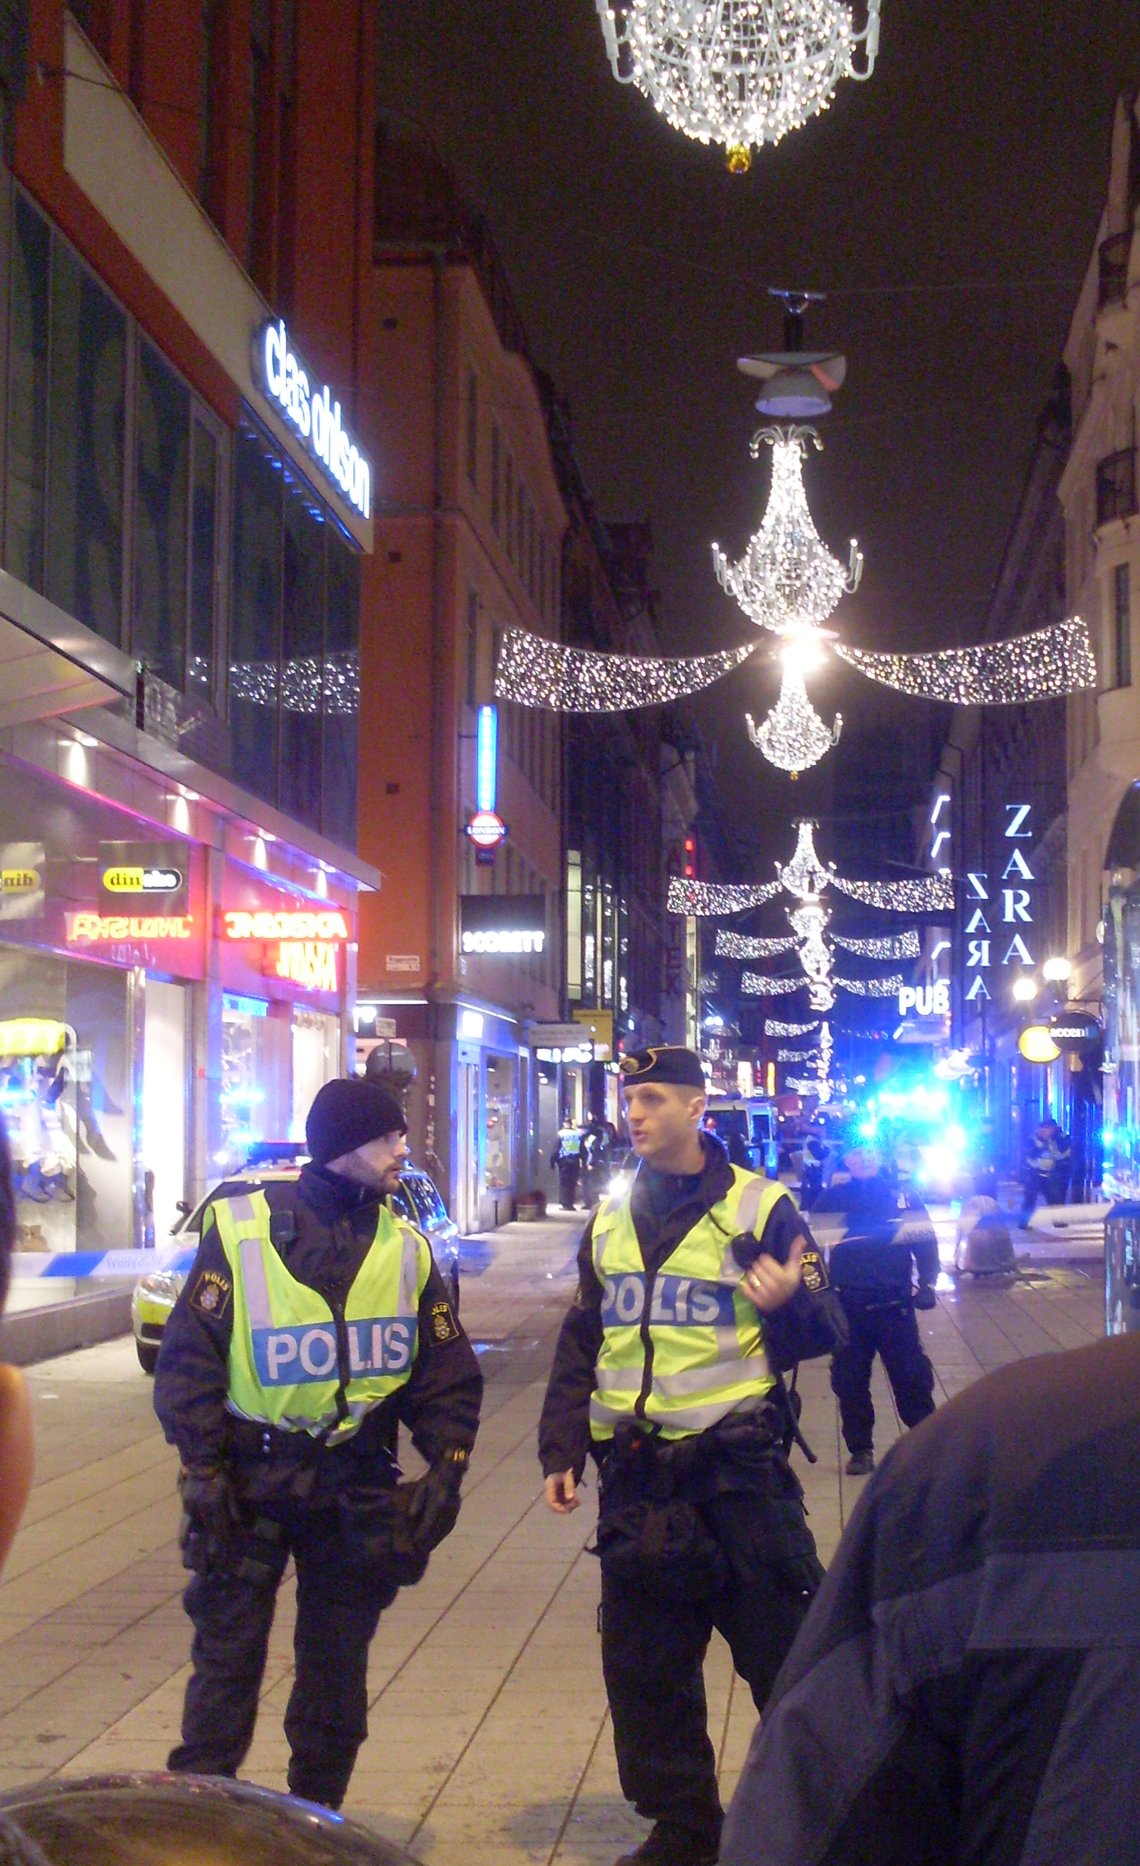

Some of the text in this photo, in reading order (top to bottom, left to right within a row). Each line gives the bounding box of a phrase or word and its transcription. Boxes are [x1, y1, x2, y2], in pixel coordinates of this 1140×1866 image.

[467, 825, 505, 837] LONDON
[1002, 803, 1033, 966] ZARA
[462, 931, 545, 953] SCORETT
[899, 984, 950, 1016] PUB
[202, 1272, 229, 1291] POLIS
[266, 1323, 410, 1380] POLIS
